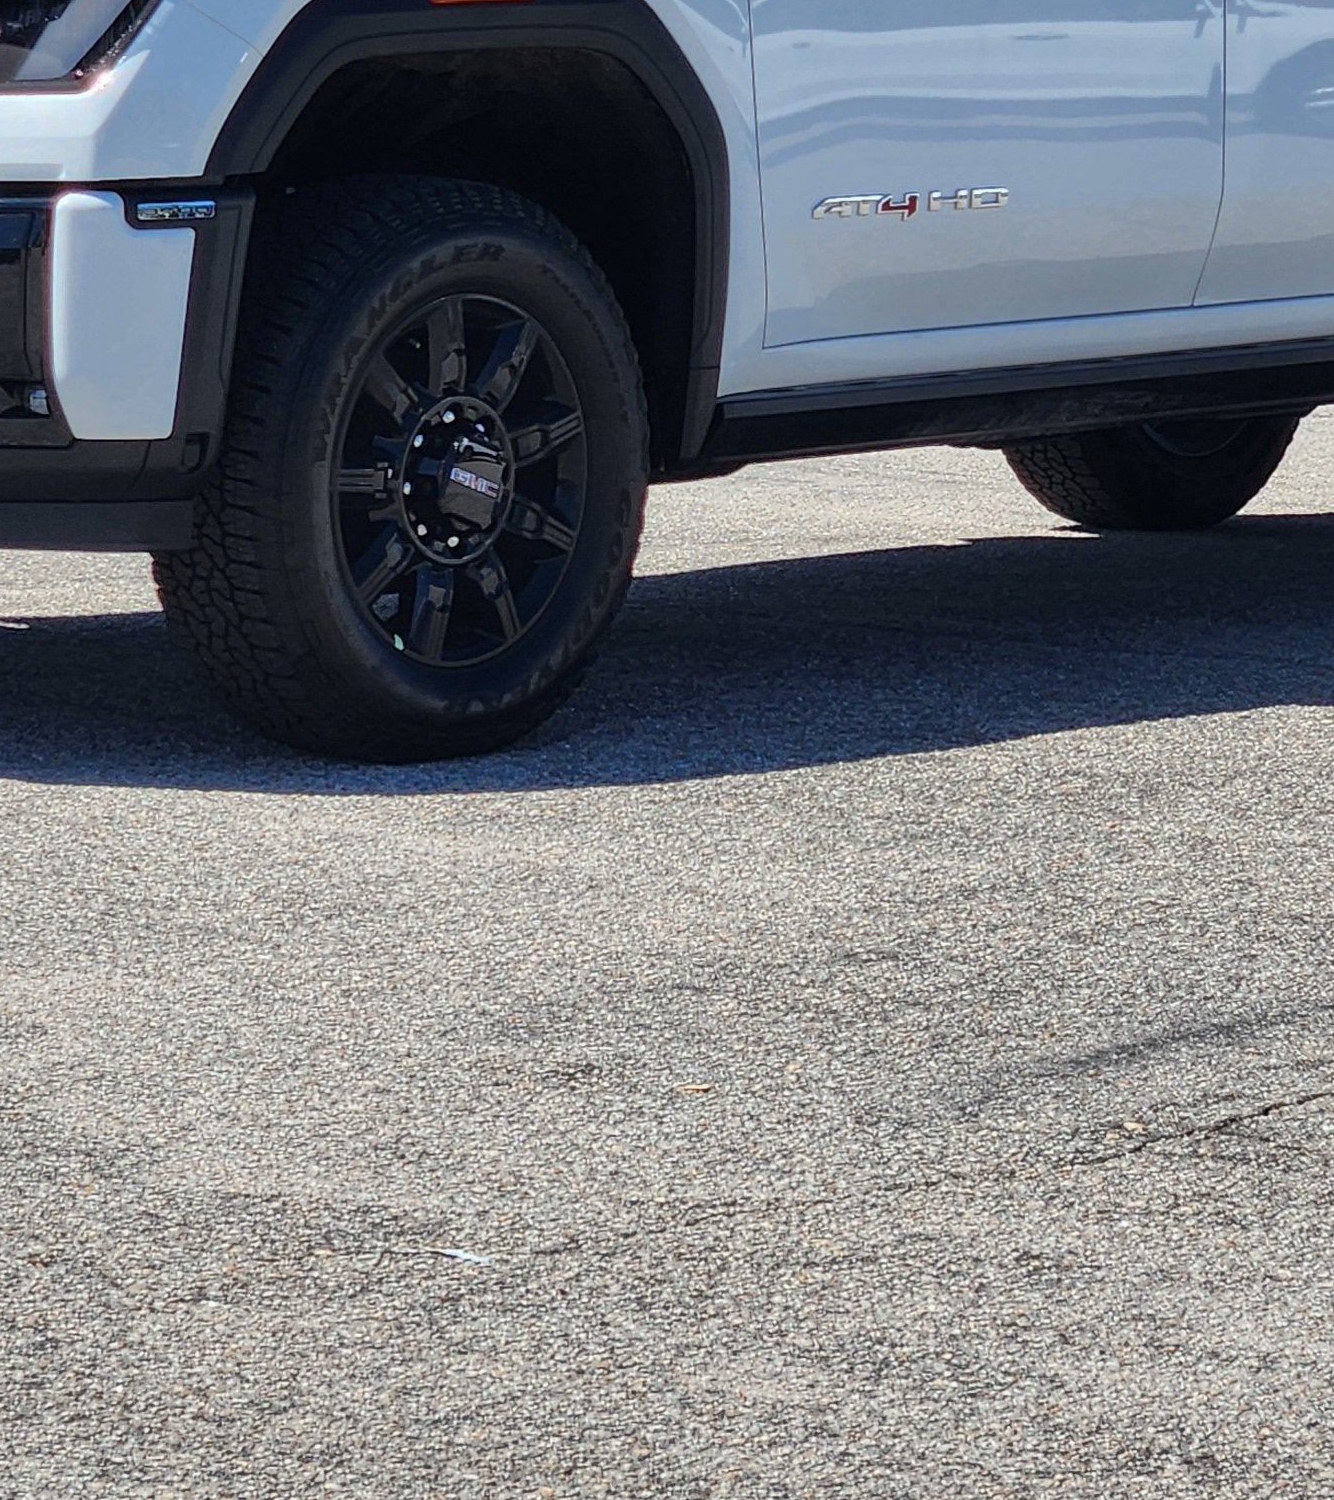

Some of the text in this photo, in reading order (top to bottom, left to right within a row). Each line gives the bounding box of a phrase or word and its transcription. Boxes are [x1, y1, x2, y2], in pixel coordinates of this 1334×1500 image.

[811, 185, 1010, 222] AT4 HD
[450, 467, 499, 498] GMC
